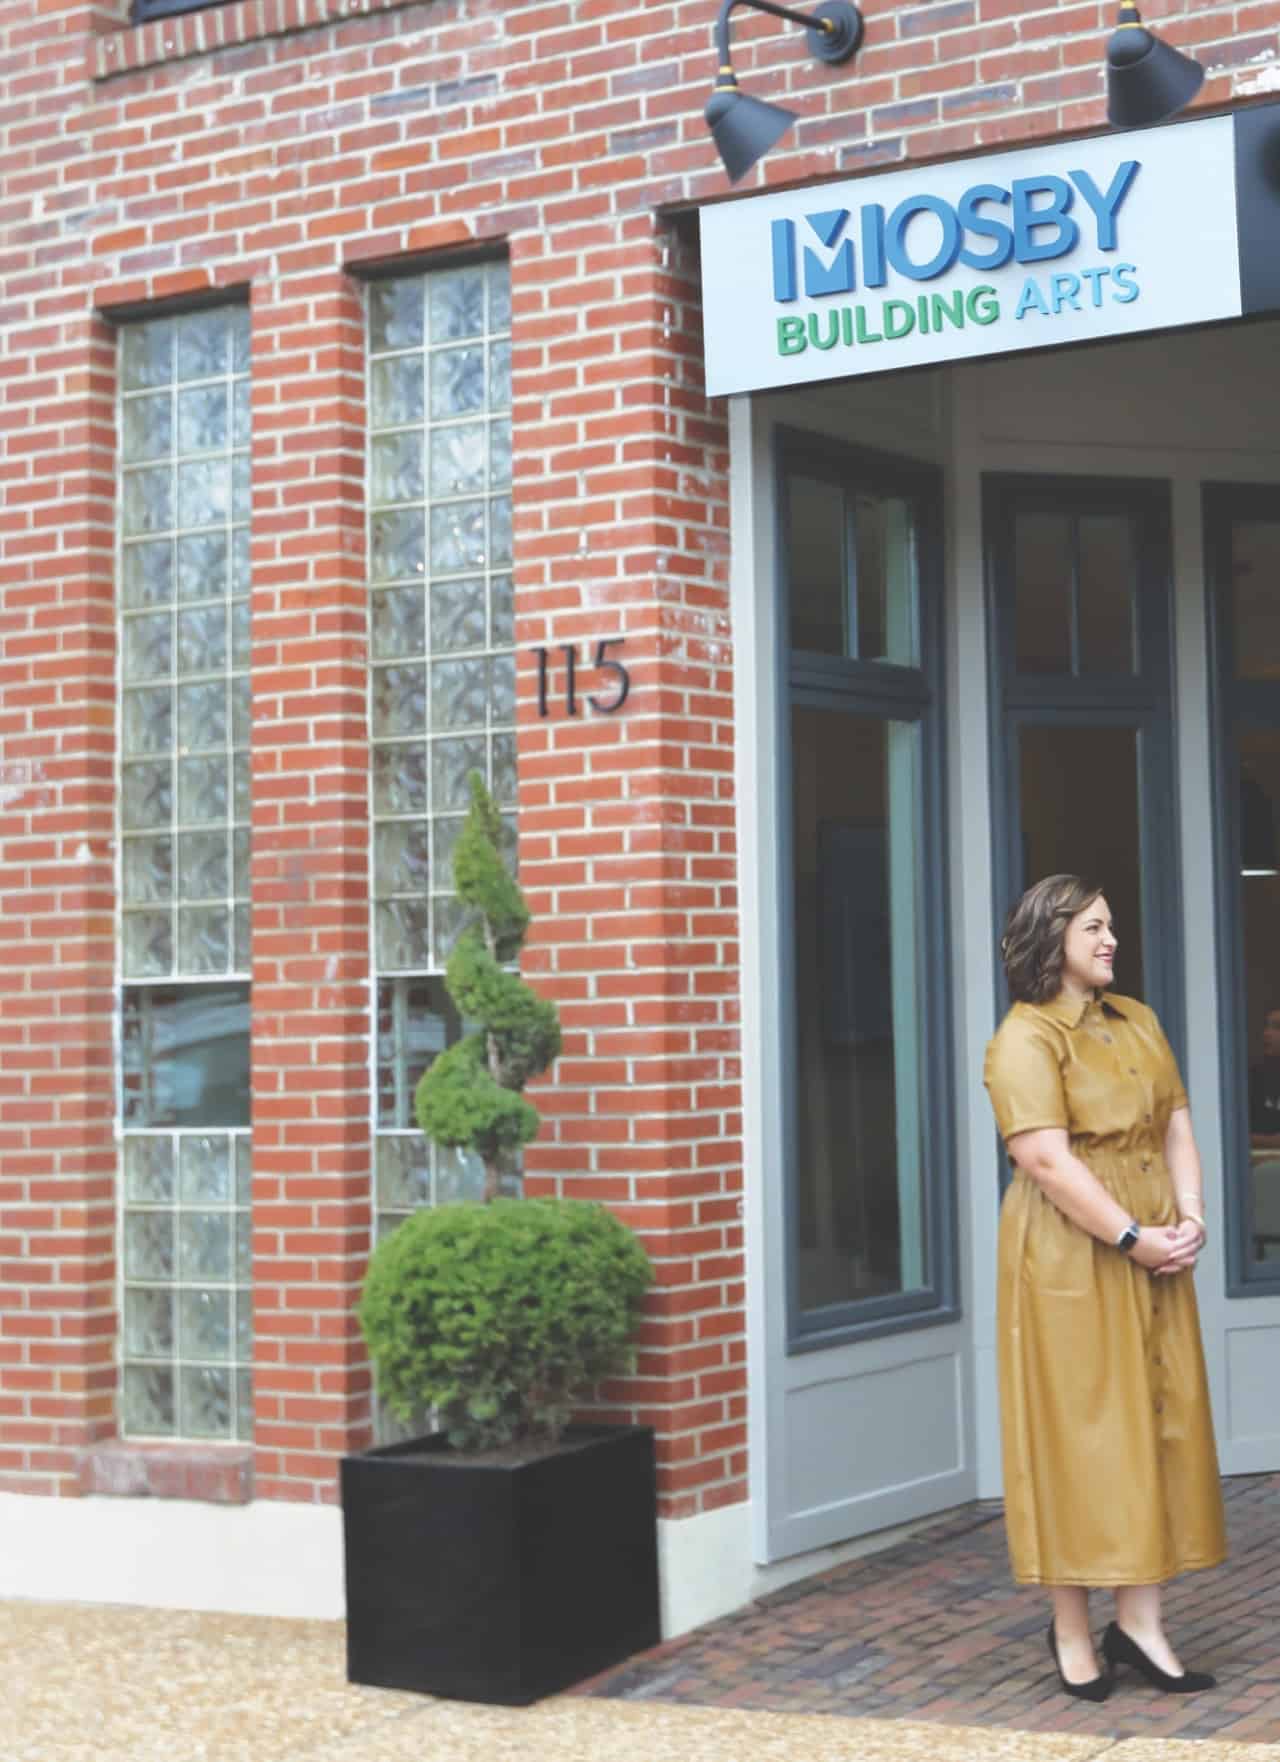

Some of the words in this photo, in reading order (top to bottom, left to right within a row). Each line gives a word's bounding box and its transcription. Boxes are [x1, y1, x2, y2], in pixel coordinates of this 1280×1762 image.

[770, 160, 1143, 303] MOSBY
[776, 285, 1000, 357] BUILDING
[1014, 263, 1141, 320] ARTS
[529, 638, 629, 717] 115
